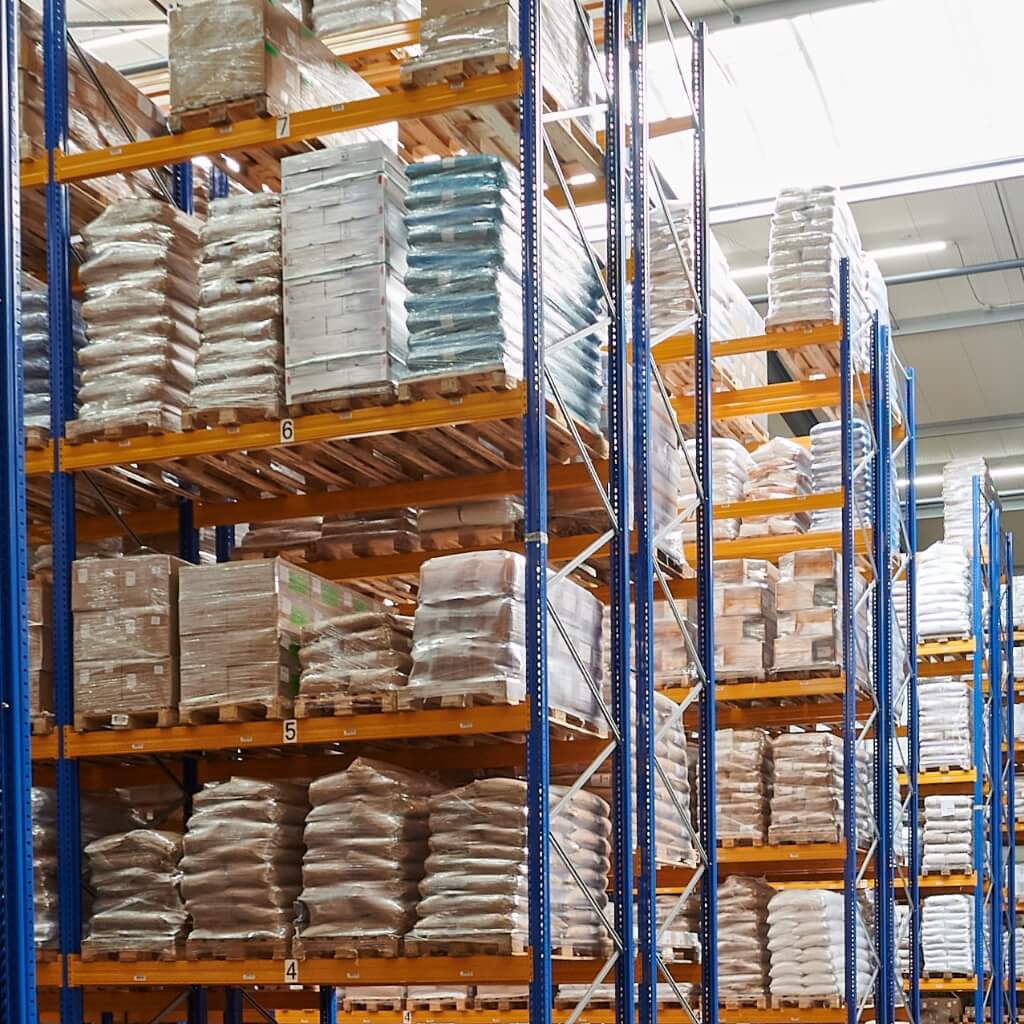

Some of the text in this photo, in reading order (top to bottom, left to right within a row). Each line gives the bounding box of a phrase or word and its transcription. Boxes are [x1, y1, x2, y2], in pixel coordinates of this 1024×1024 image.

[278, 116, 287, 136] 7
[282, 420, 293, 440] 6
[285, 721, 296, 741] 5
[286, 961, 297, 980] 4
